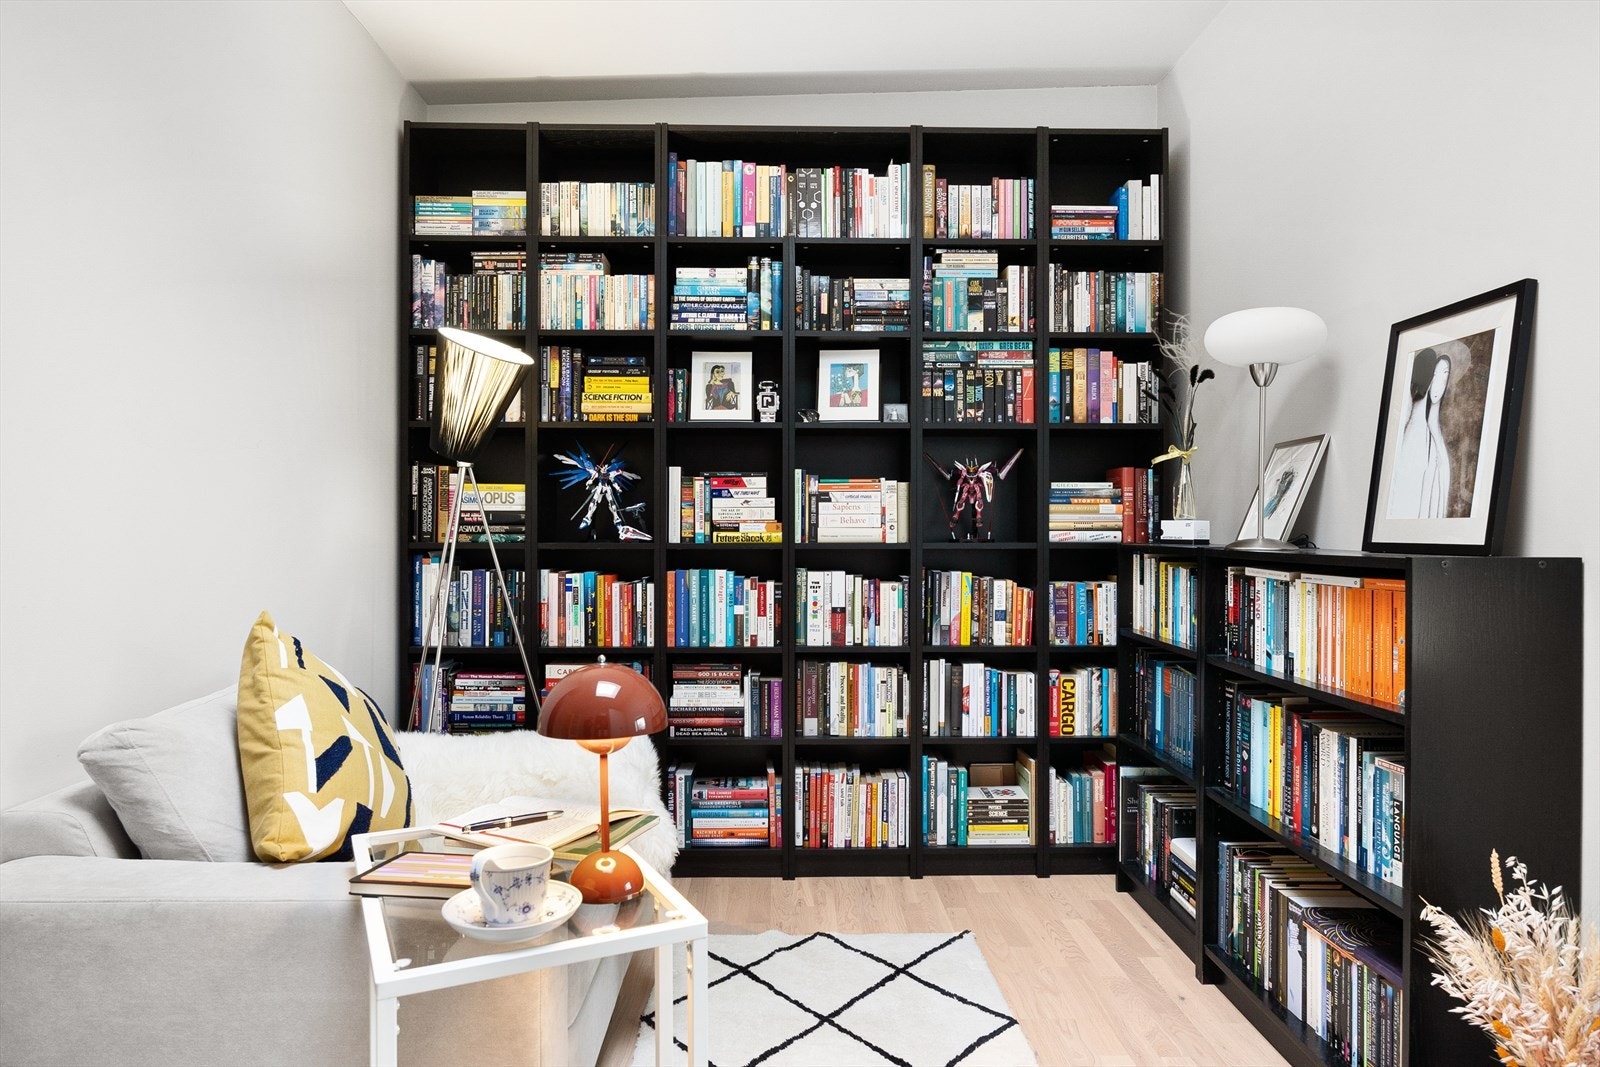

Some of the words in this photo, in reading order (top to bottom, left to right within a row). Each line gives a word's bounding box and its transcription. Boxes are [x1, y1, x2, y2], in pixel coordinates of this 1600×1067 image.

[484, 492, 515, 504] OPUS
[832, 503, 860, 512] Sapiens
[716, 533, 741, 542] Future
[1062, 679, 1075, 735] CARGO
